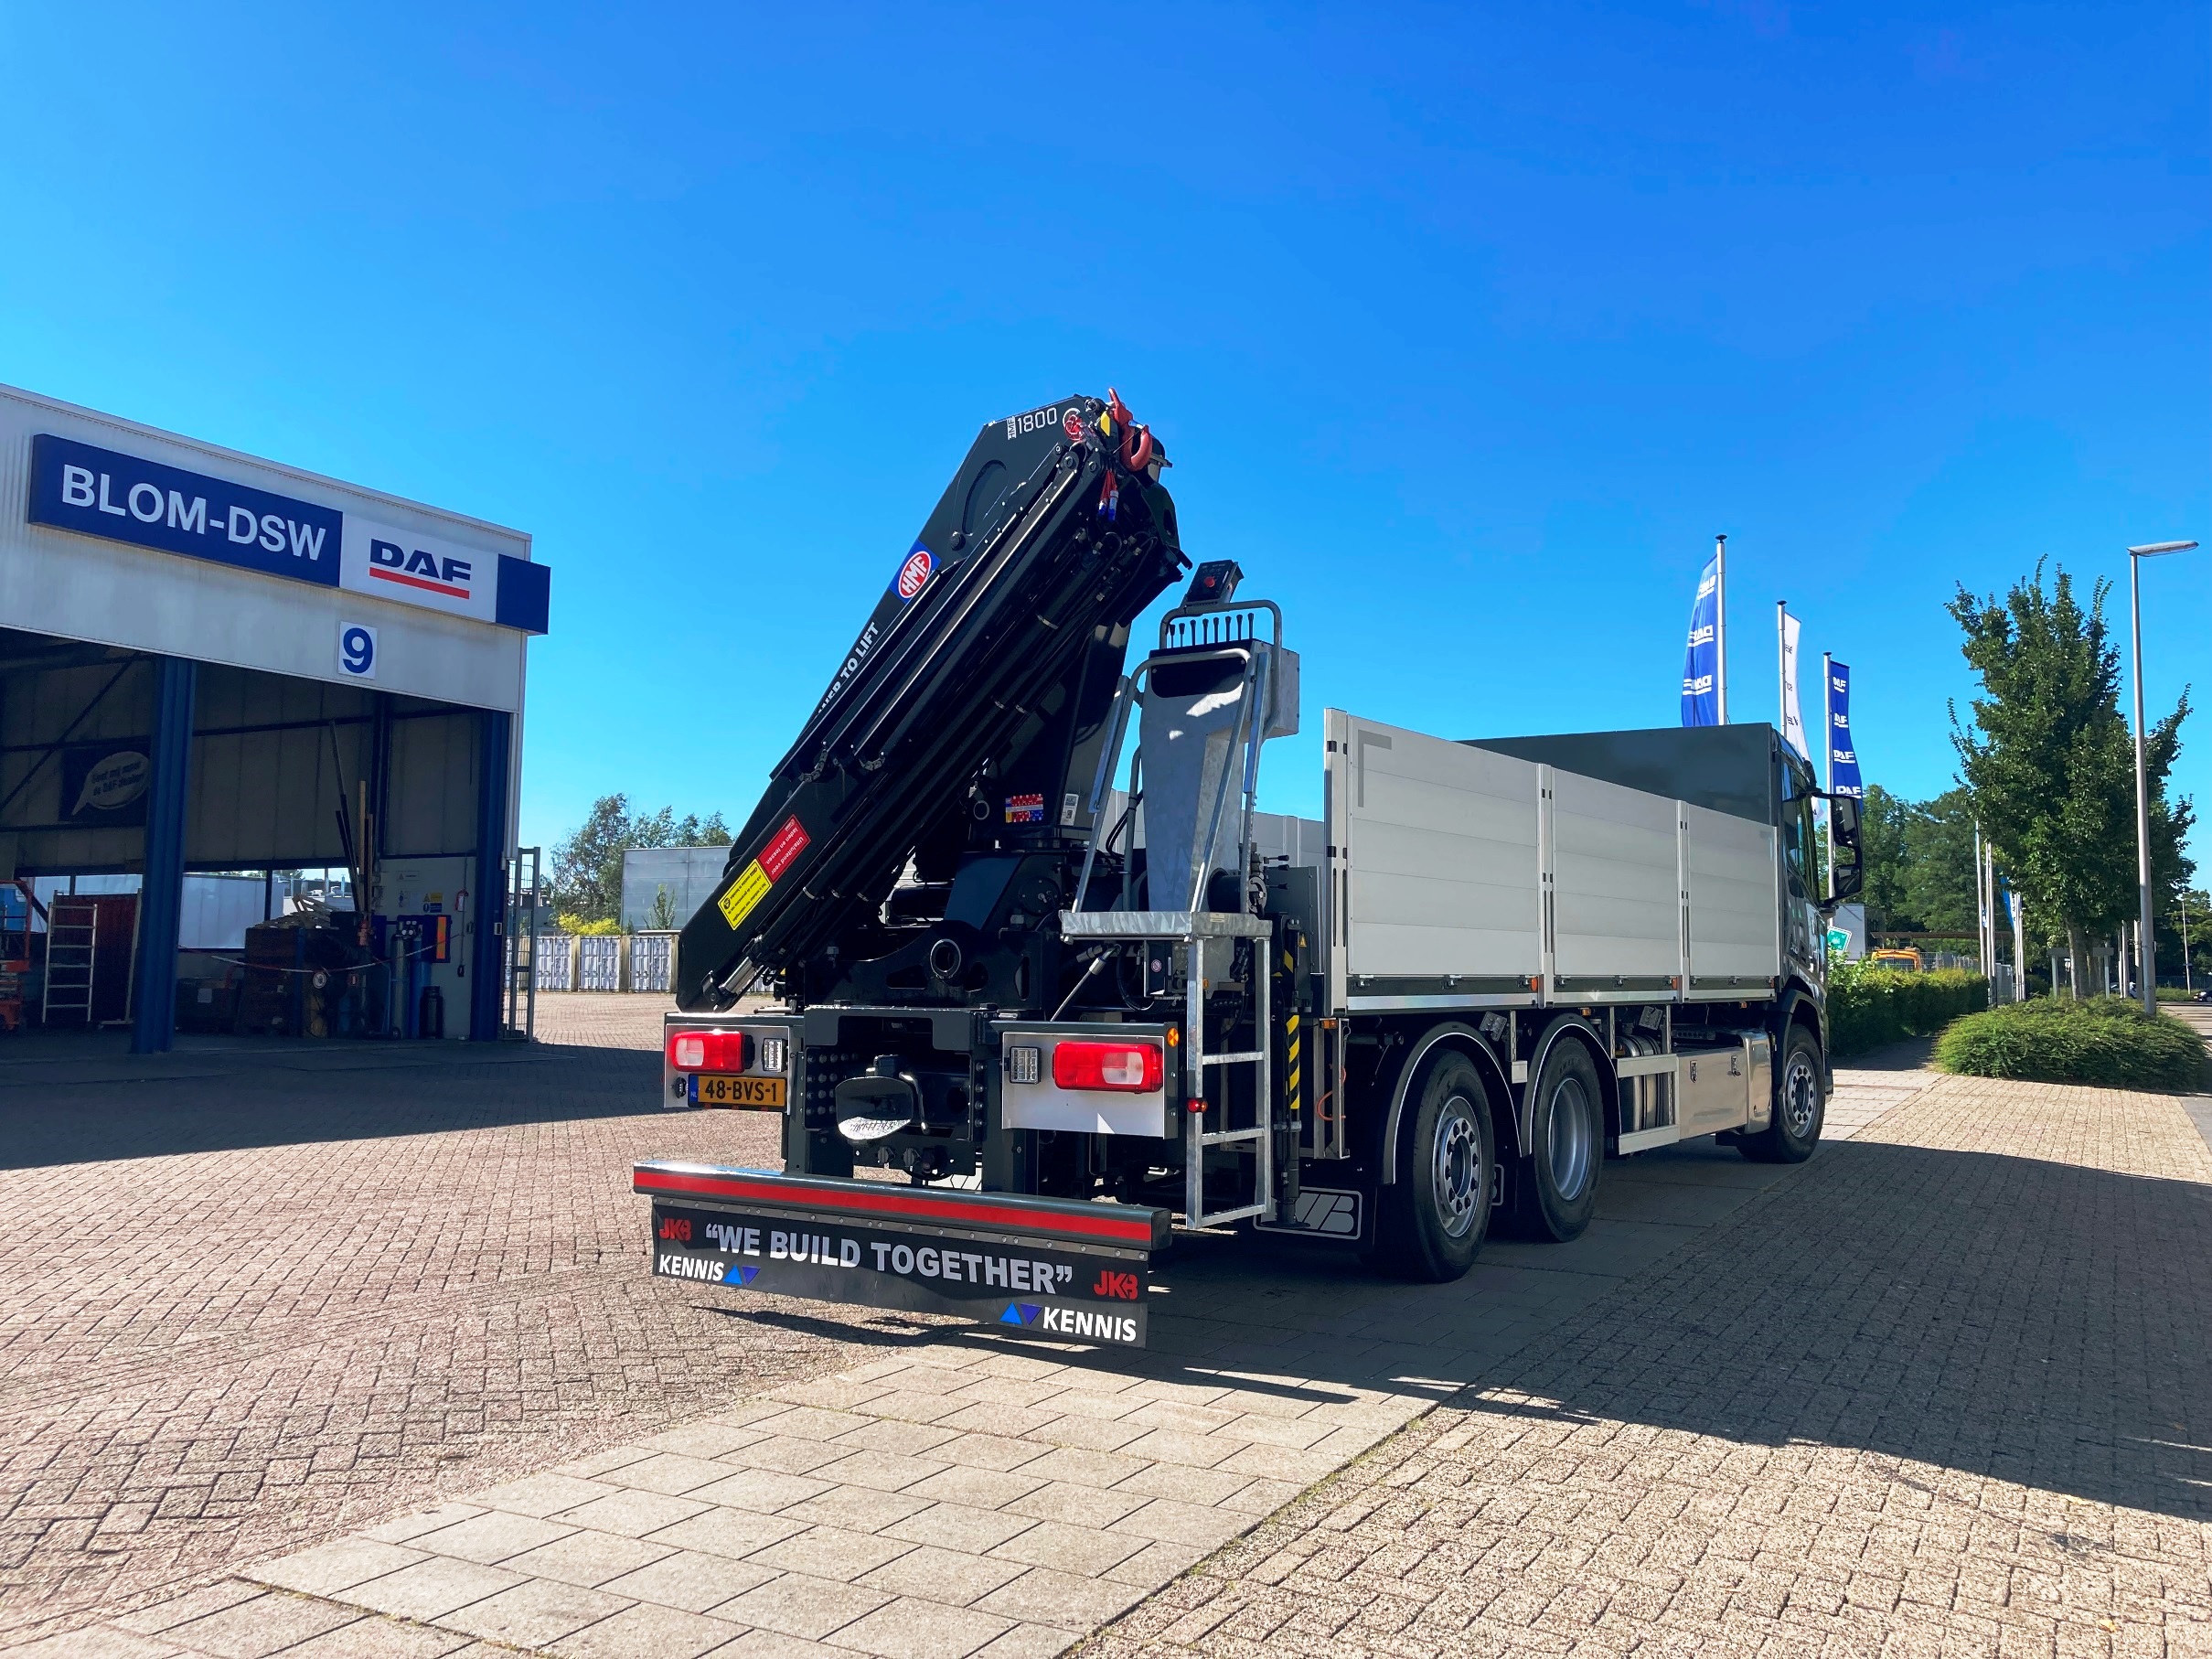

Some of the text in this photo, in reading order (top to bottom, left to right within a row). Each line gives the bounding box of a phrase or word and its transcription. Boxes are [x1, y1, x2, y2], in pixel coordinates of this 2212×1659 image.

[1018, 407, 1058, 434] 1800
[62, 464, 326, 561] BLOM-DSW
[369, 539, 472, 582] DAF
[901, 555, 927, 594] HMF
[342, 627, 373, 674] 9
[840, 621, 879, 679] TO LIFT
[1833, 750, 1854, 760] DAF
[1836, 786, 1862, 795] DAF
[705, 1080, 777, 1102] 48-BVS-1
[658, 1254, 725, 1281] KENNIS
[769, 1230, 861, 1268] BUILD
[1042, 1306, 1137, 1343] KENNIS
